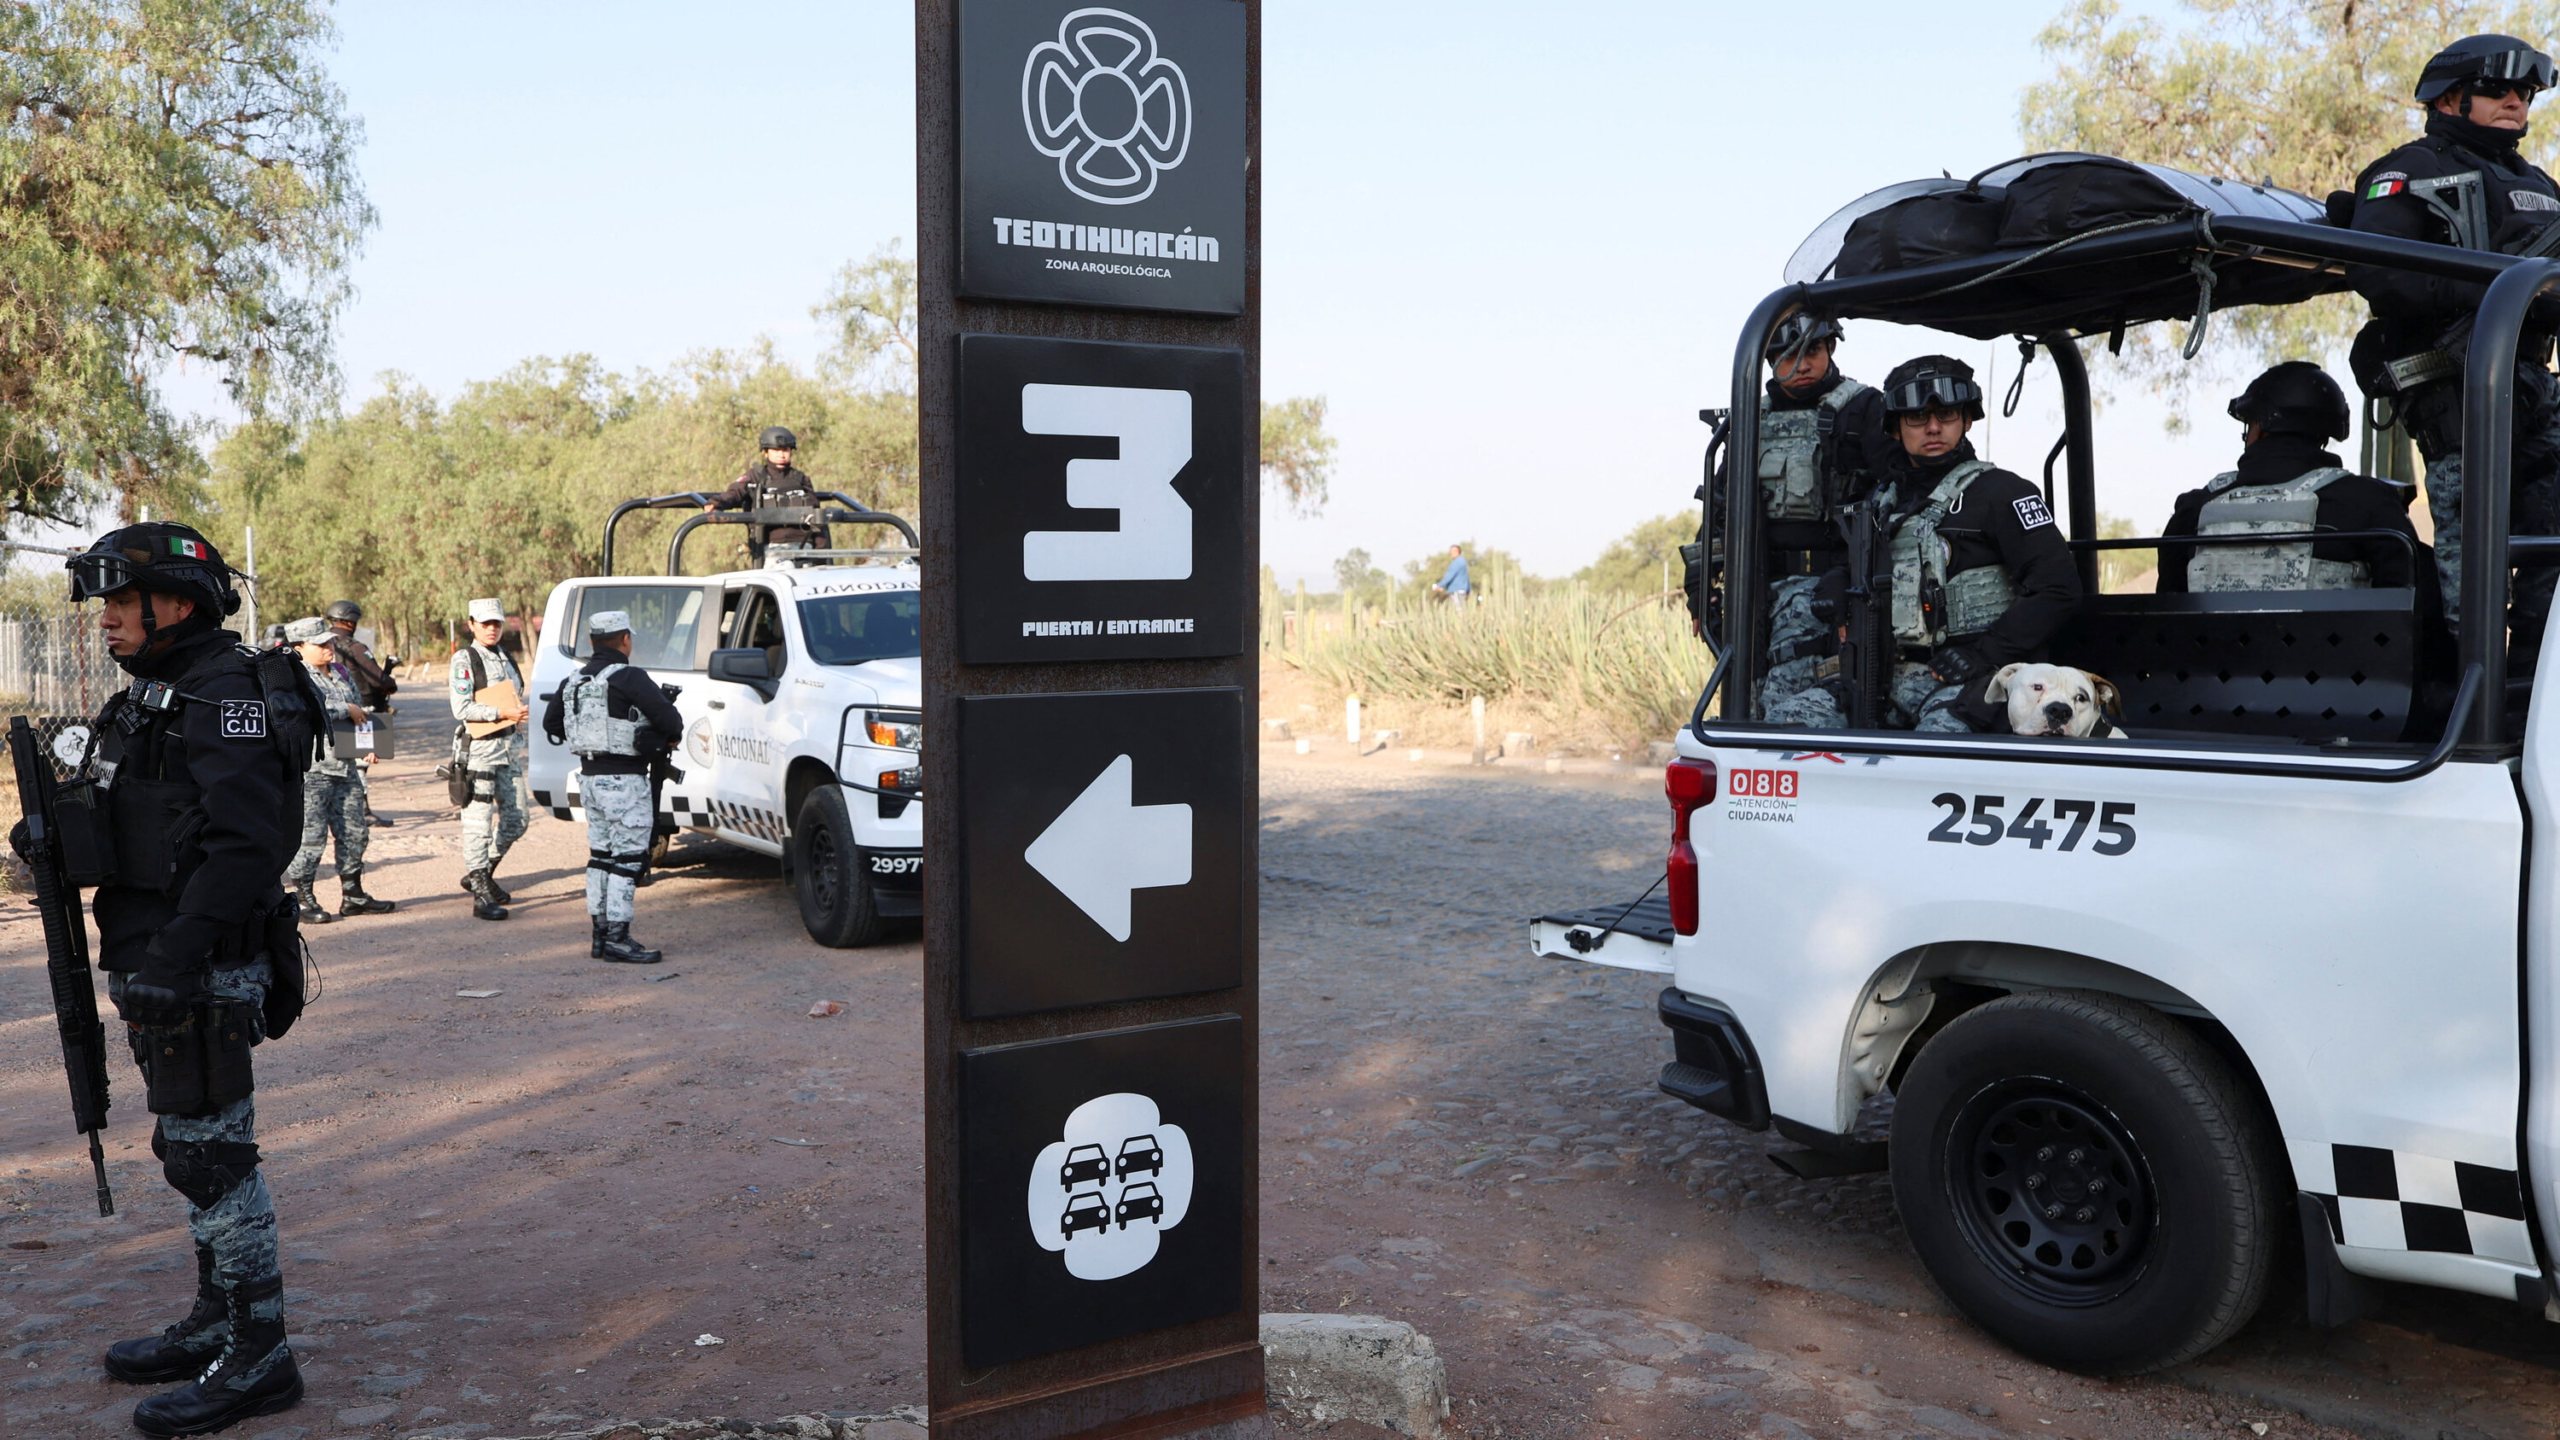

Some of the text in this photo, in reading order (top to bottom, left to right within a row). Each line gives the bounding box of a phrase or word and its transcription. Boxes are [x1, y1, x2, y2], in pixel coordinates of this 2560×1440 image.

[993, 217, 1219, 262] TEOTIHUACÁN
[1045, 259, 1172, 278] ZONA ARQUEOLÓGICA
[1022, 383, 1192, 581] 3
[2025, 510, 2049, 525] C.U.
[1022, 621, 1094, 637] PUERTA
[1107, 619, 1194, 634] ENTRANCE
[227, 719, 261, 733] C.U.
[716, 733, 770, 765] NACIONAL
[1732, 772, 1795, 796] 088
[1735, 798, 1789, 810] ATENCIÓN
[1728, 810, 1794, 823] CIUDADANA
[1927, 792, 2137, 856] 25475
